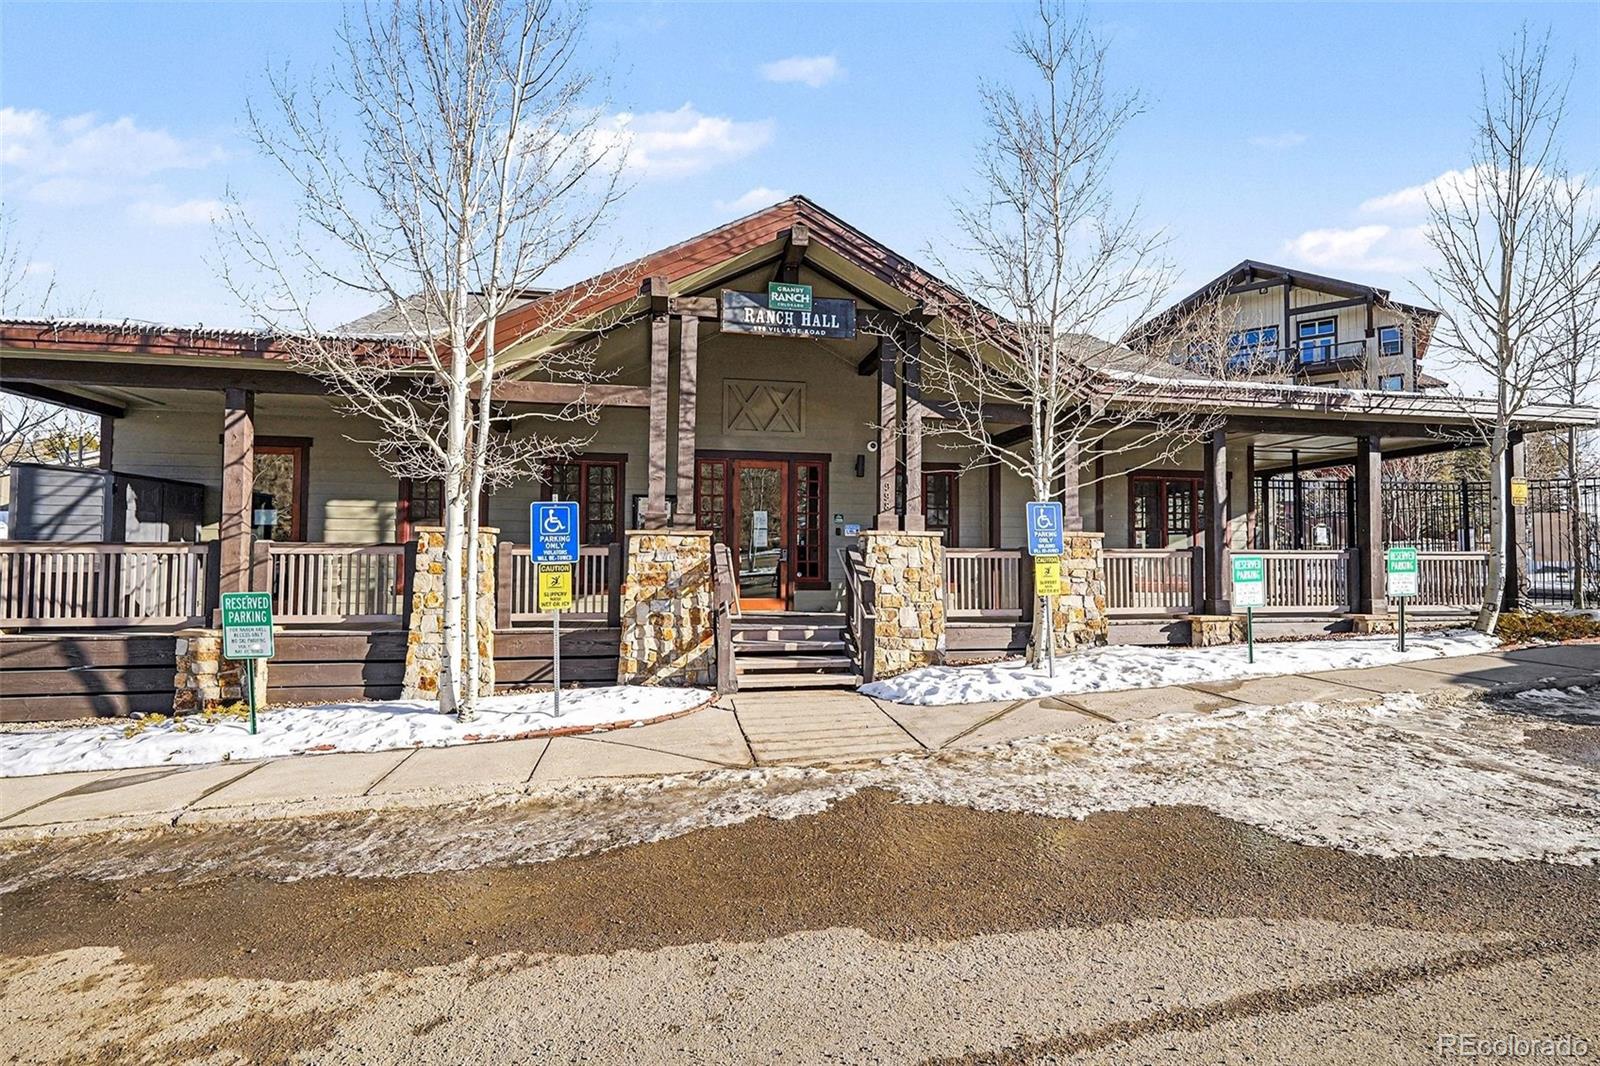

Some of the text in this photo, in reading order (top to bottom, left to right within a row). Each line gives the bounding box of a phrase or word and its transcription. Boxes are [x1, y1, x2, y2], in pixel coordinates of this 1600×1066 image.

[771, 292, 810, 303] RANCH
[744, 307, 840, 329] RANCH HALL
[768, 326, 801, 335] VILLAGE
[225, 597, 269, 610] RESERVED
[228, 611, 267, 623] PARKING
